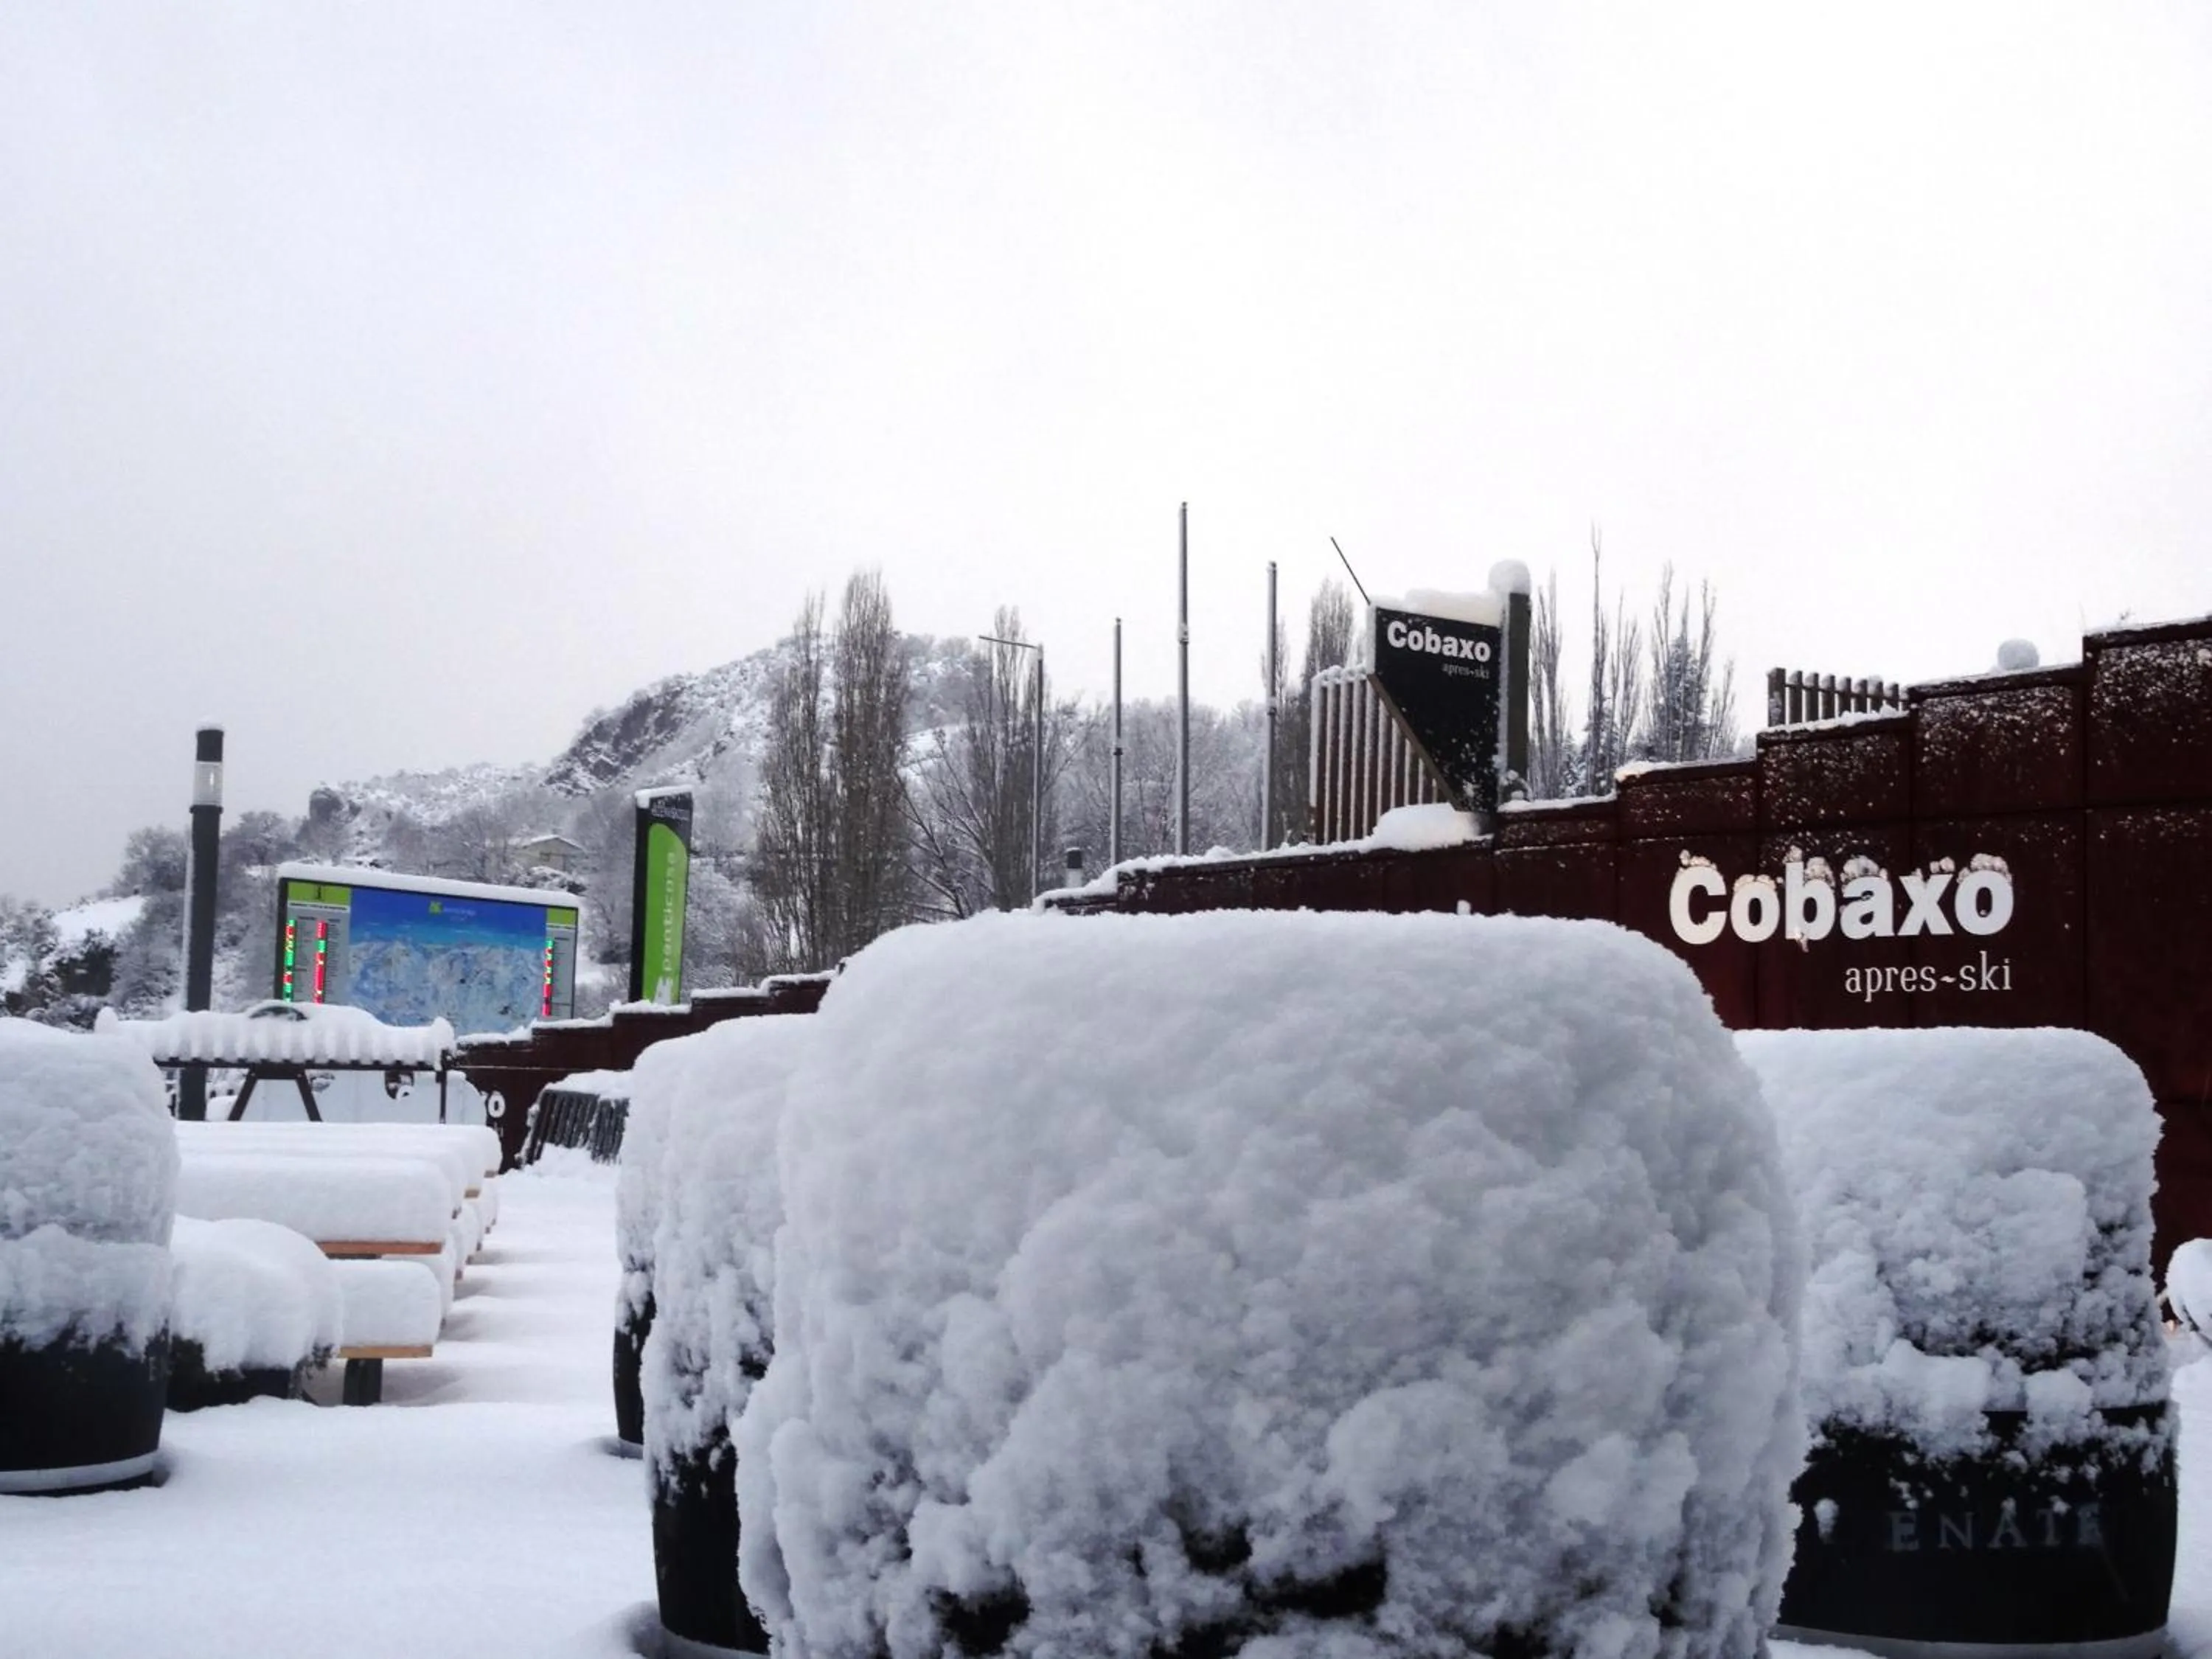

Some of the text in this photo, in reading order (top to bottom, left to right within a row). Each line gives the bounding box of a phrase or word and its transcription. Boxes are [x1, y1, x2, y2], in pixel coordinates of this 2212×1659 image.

[1387, 620, 1492, 662] Cobaxo
[1669, 861, 2014, 945] Cobaxo
[1888, 1502, 2104, 1552] ENATE
